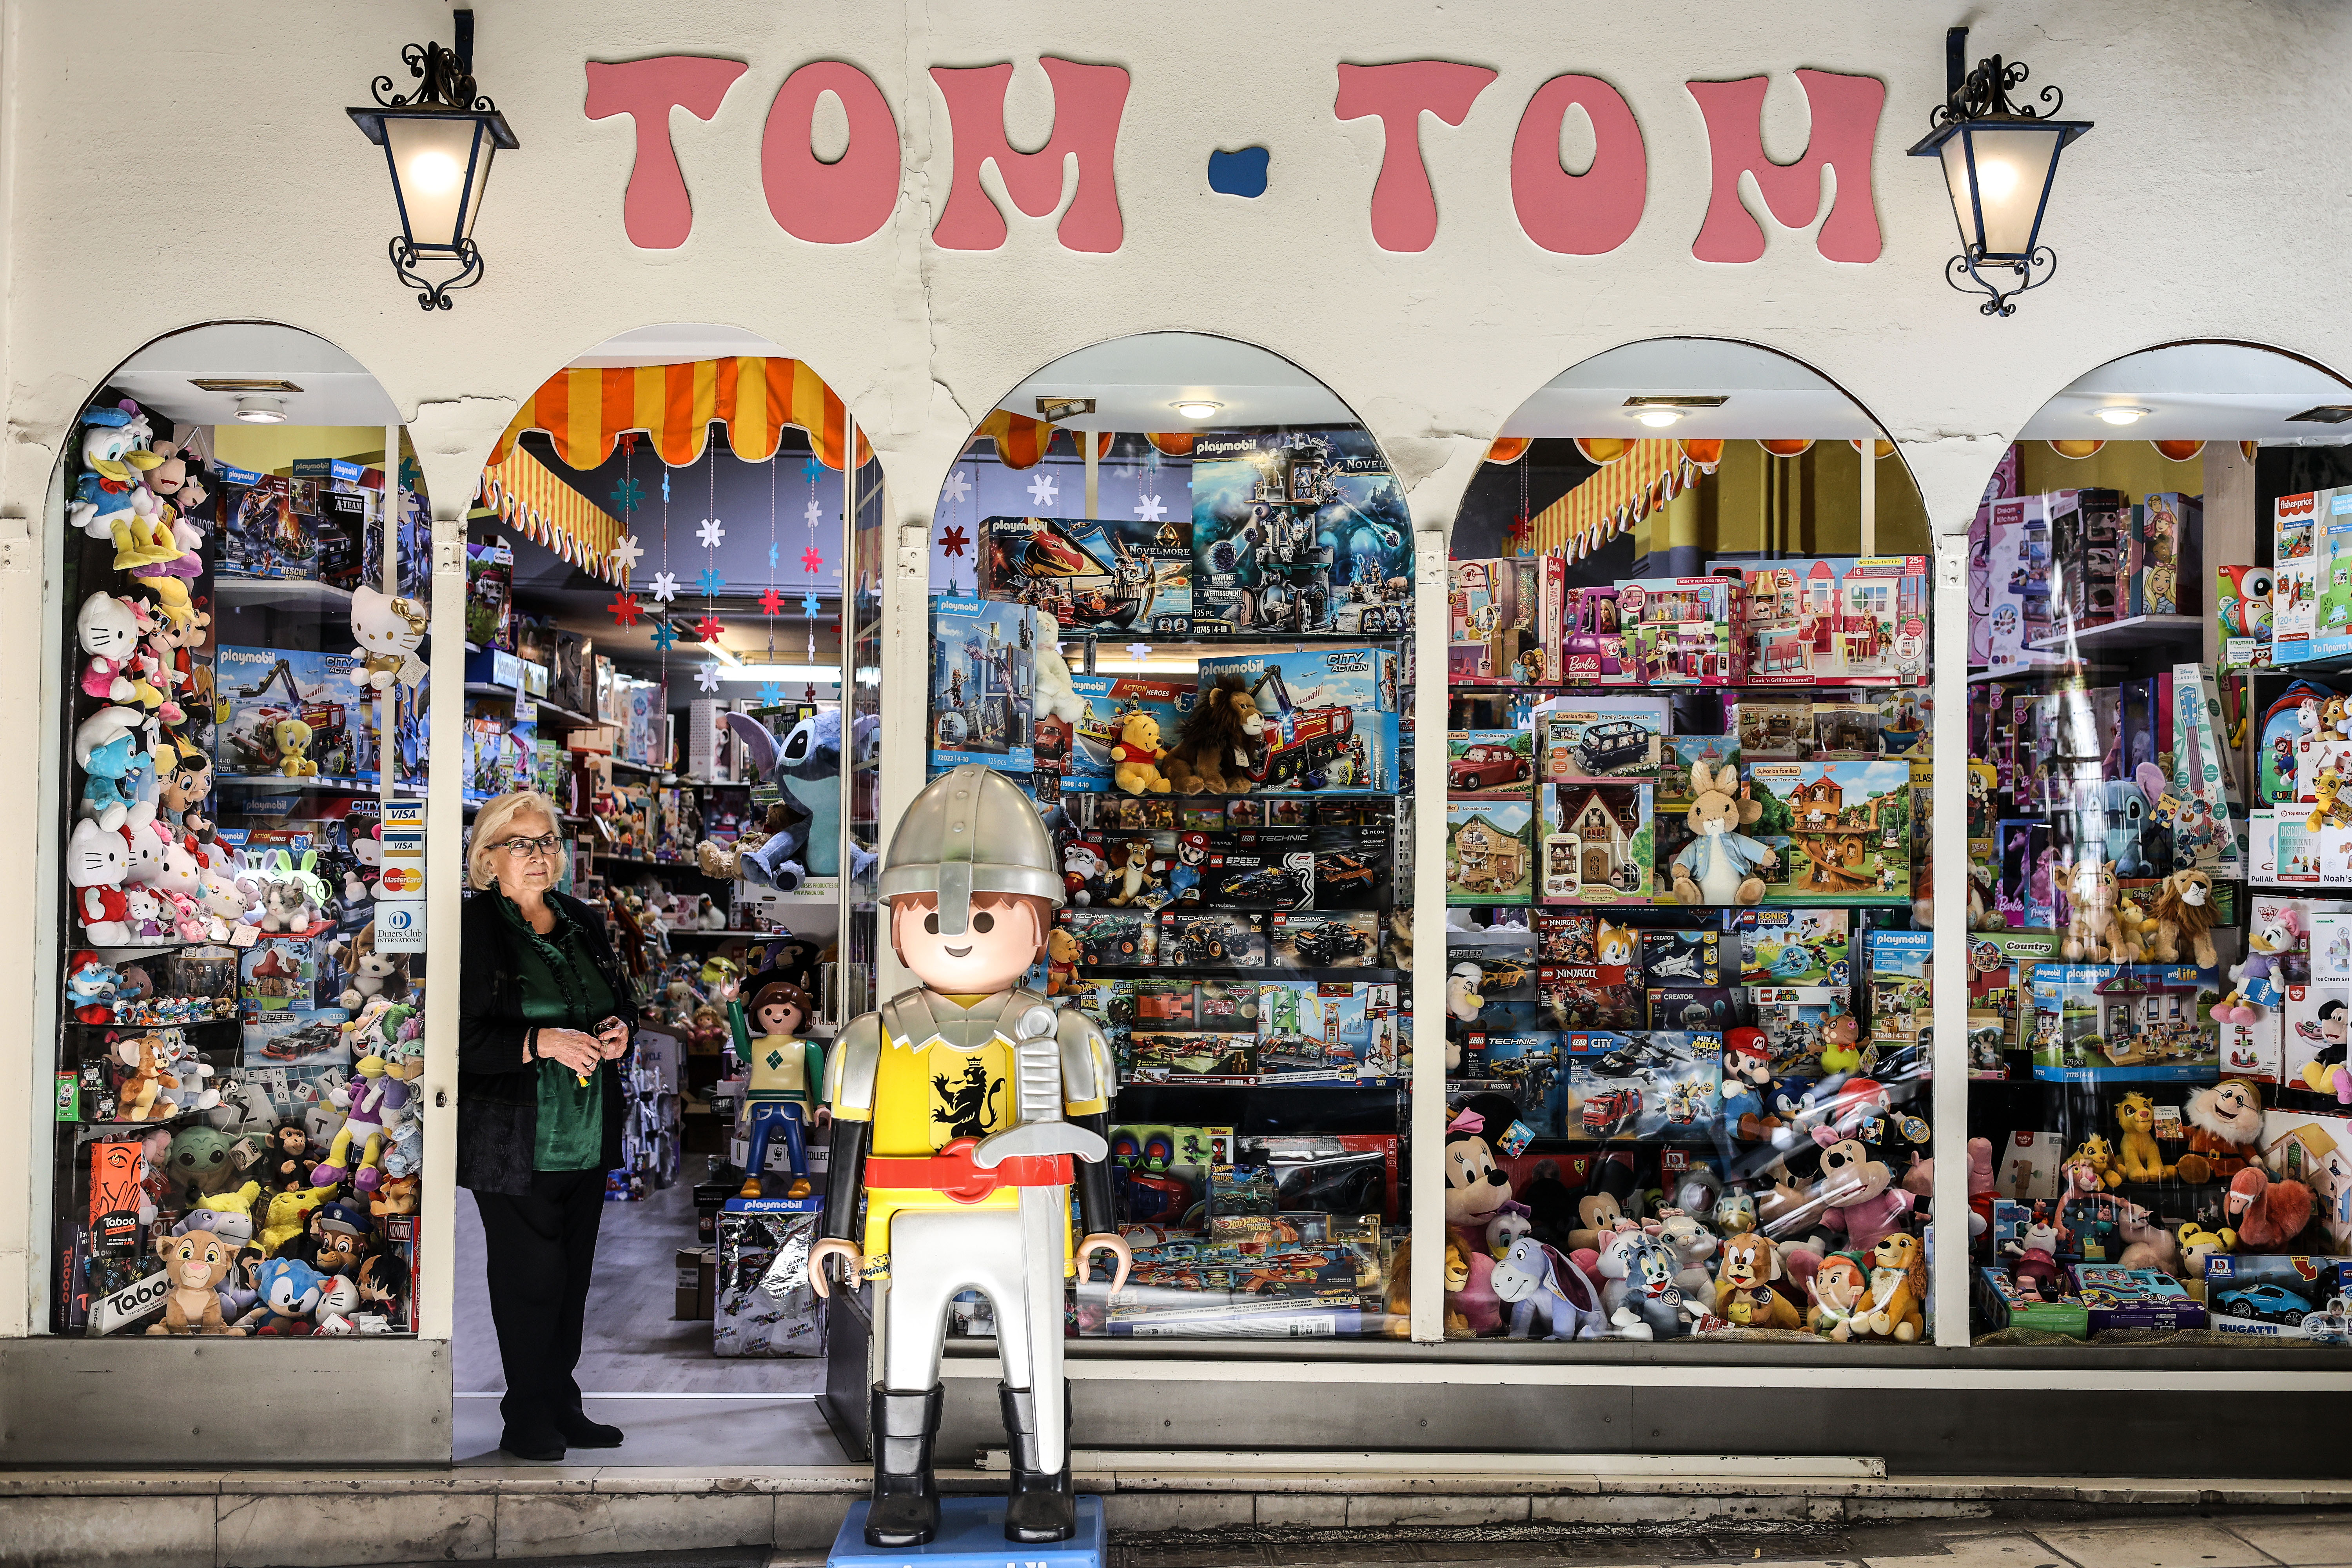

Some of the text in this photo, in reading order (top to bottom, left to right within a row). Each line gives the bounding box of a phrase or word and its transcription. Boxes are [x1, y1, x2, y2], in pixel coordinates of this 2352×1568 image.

[585, 55, 1131, 253] TOM
[1334, 60, 1885, 263] TOM
[1196, 439, 1256, 454] playmobil
[333, 464, 358, 476] playmobil
[229, 471, 254, 481] playmobil
[993, 520, 1047, 532] playmobil
[1130, 546, 1190, 557] NOVELMORE
[281, 566, 307, 577] RESCUE
[1549, 560, 1560, 572] Barbie
[941, 603, 978, 612] playmobil
[2323, 643, 2346, 653] Πρώτο
[221, 649, 275, 664] playmobil
[326, 657, 353, 667] CITY
[1327, 653, 1364, 664] CITY
[1331, 664, 1368, 672] ACTION
[1569, 655, 1599, 671] Barbie
[1201, 660, 1264, 678] playmobil
[247, 801, 287, 810] playmobil
[352, 801, 380, 811] CITY
[391, 810, 416, 819] VISA
[1999, 898, 2024, 912] Barbie
[1877, 935, 1927, 945] playmobil
[1555, 969, 1598, 979] NINJAGO
[2036, 969, 2060, 977] playmobil
[2067, 968, 2110, 978] playmobil
[1591, 1038, 1613, 1048] CITY
[744, 1200, 802, 1210] playmobil
[103, 1217, 135, 1227] Taboo
[390, 1223, 410, 1240] MONOPOLY
[63, 1246, 73, 1303] Taboo
[2141, 1293, 2171, 1305] Polly
[787, 1327, 814, 1339] BIRTHDAY
[789, 1323, 808, 1333] HAPPY
[2219, 1323, 2278, 1334] BUGATTI
